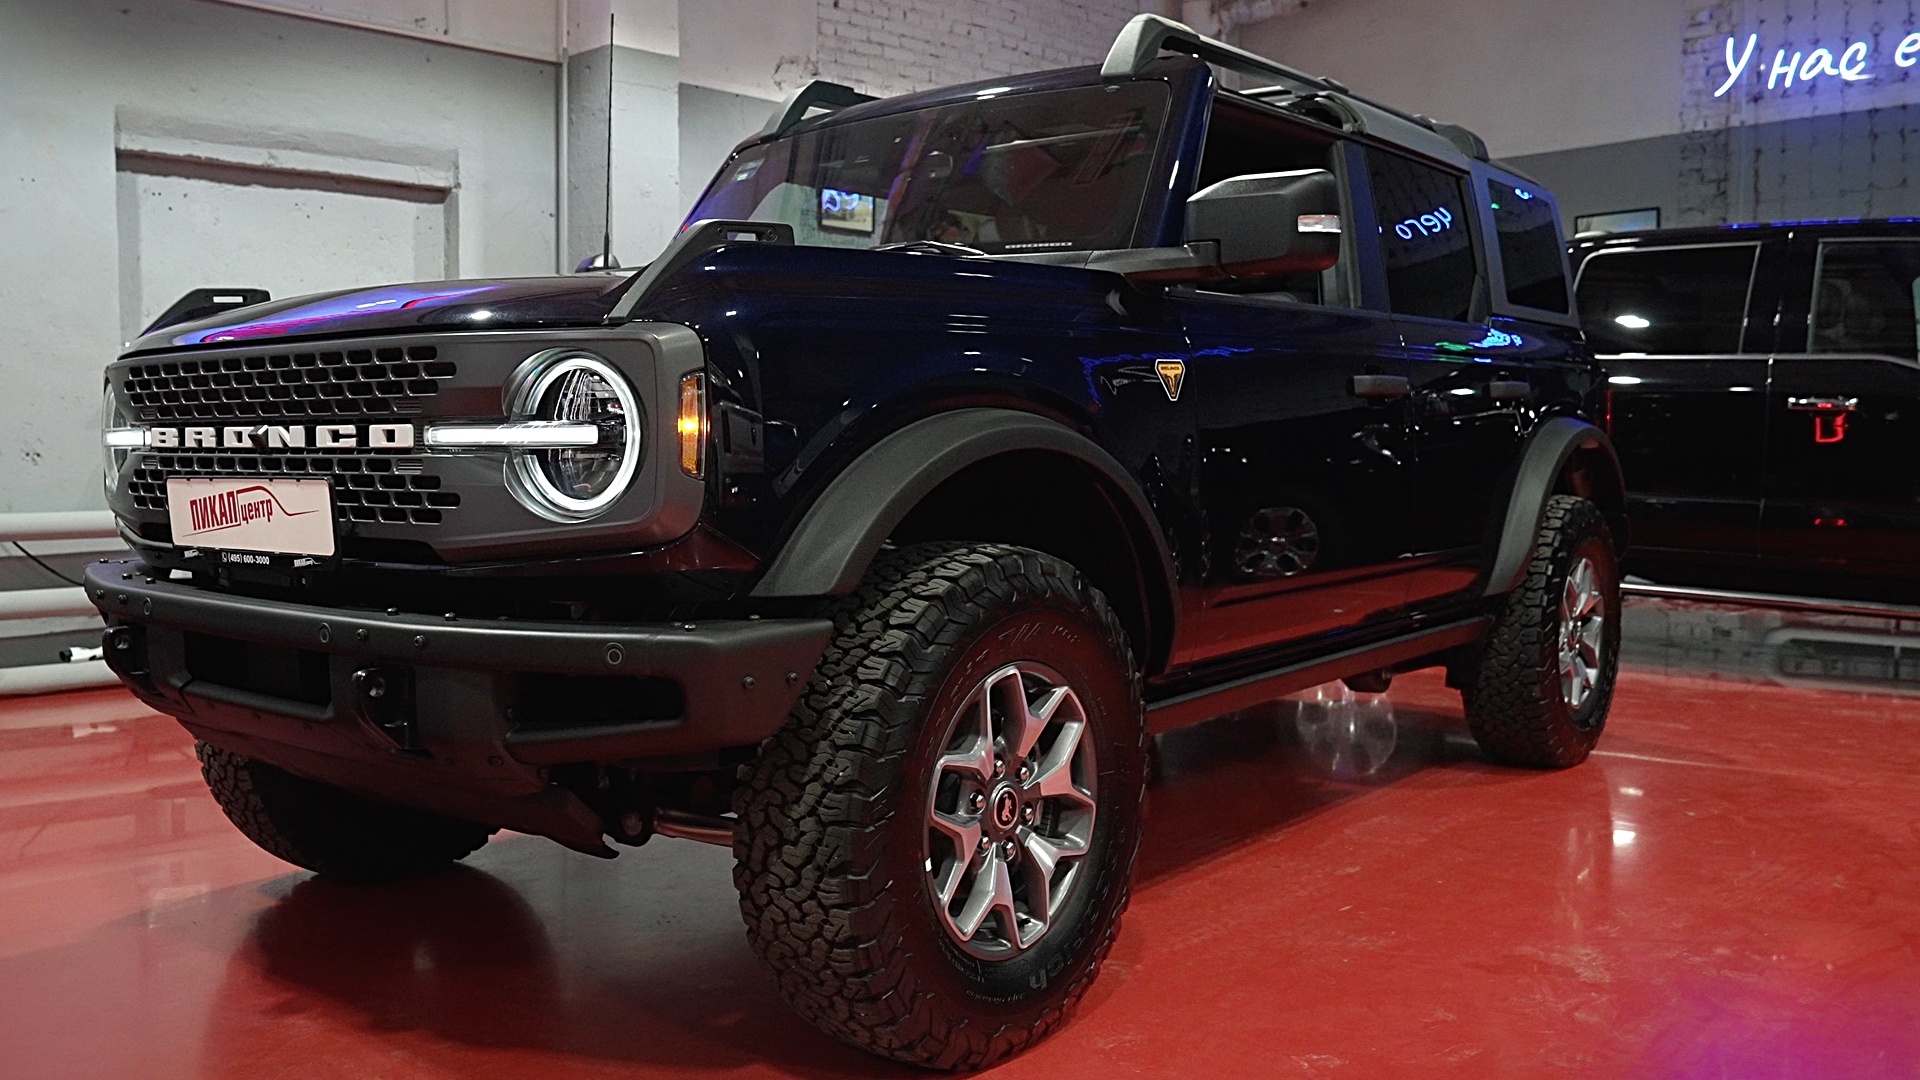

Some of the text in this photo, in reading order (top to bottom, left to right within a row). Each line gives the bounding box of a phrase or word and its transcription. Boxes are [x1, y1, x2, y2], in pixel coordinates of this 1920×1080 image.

[1714, 33, 1757, 97] У
[1767, 41, 1868, 90] нас
[227, 552, 270, 565] (495) 600-3000
